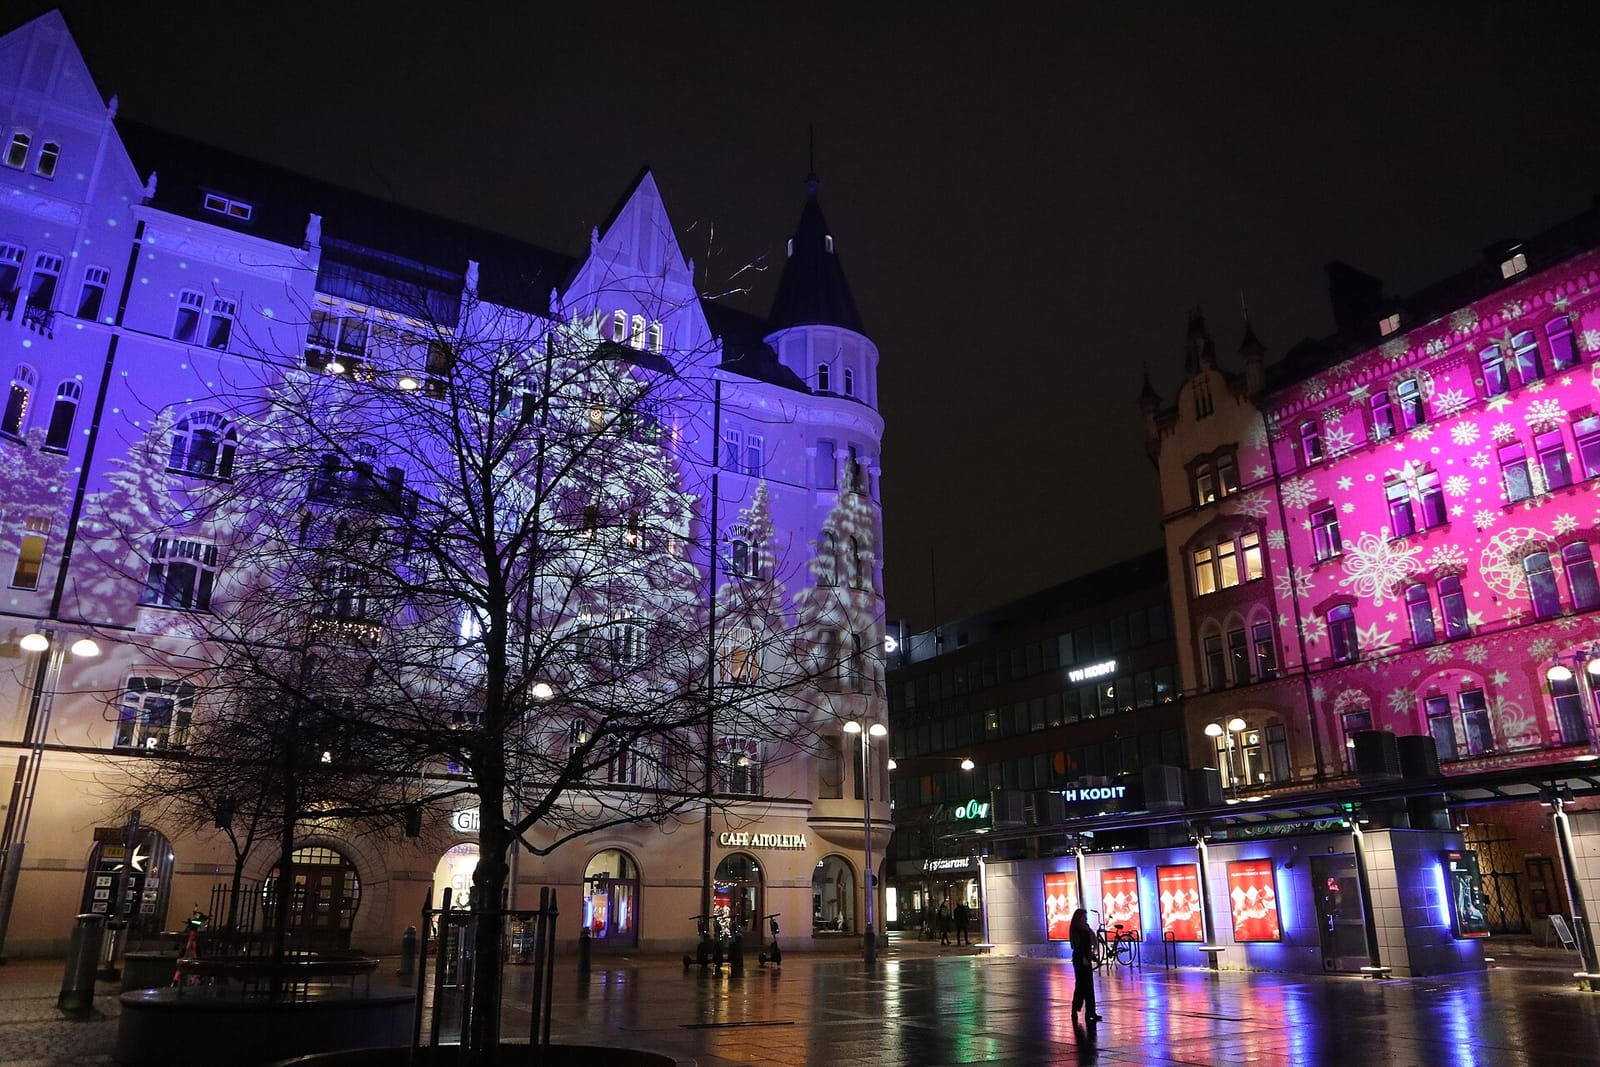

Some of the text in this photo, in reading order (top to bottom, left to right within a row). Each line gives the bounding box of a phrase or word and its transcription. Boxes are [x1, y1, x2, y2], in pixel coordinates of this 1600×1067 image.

[1084, 660, 1116, 679] KODIT
[1079, 786, 1125, 800] KODIT
[458, 812, 479, 829] Gli
[720, 831, 749, 846] CAFÉ
